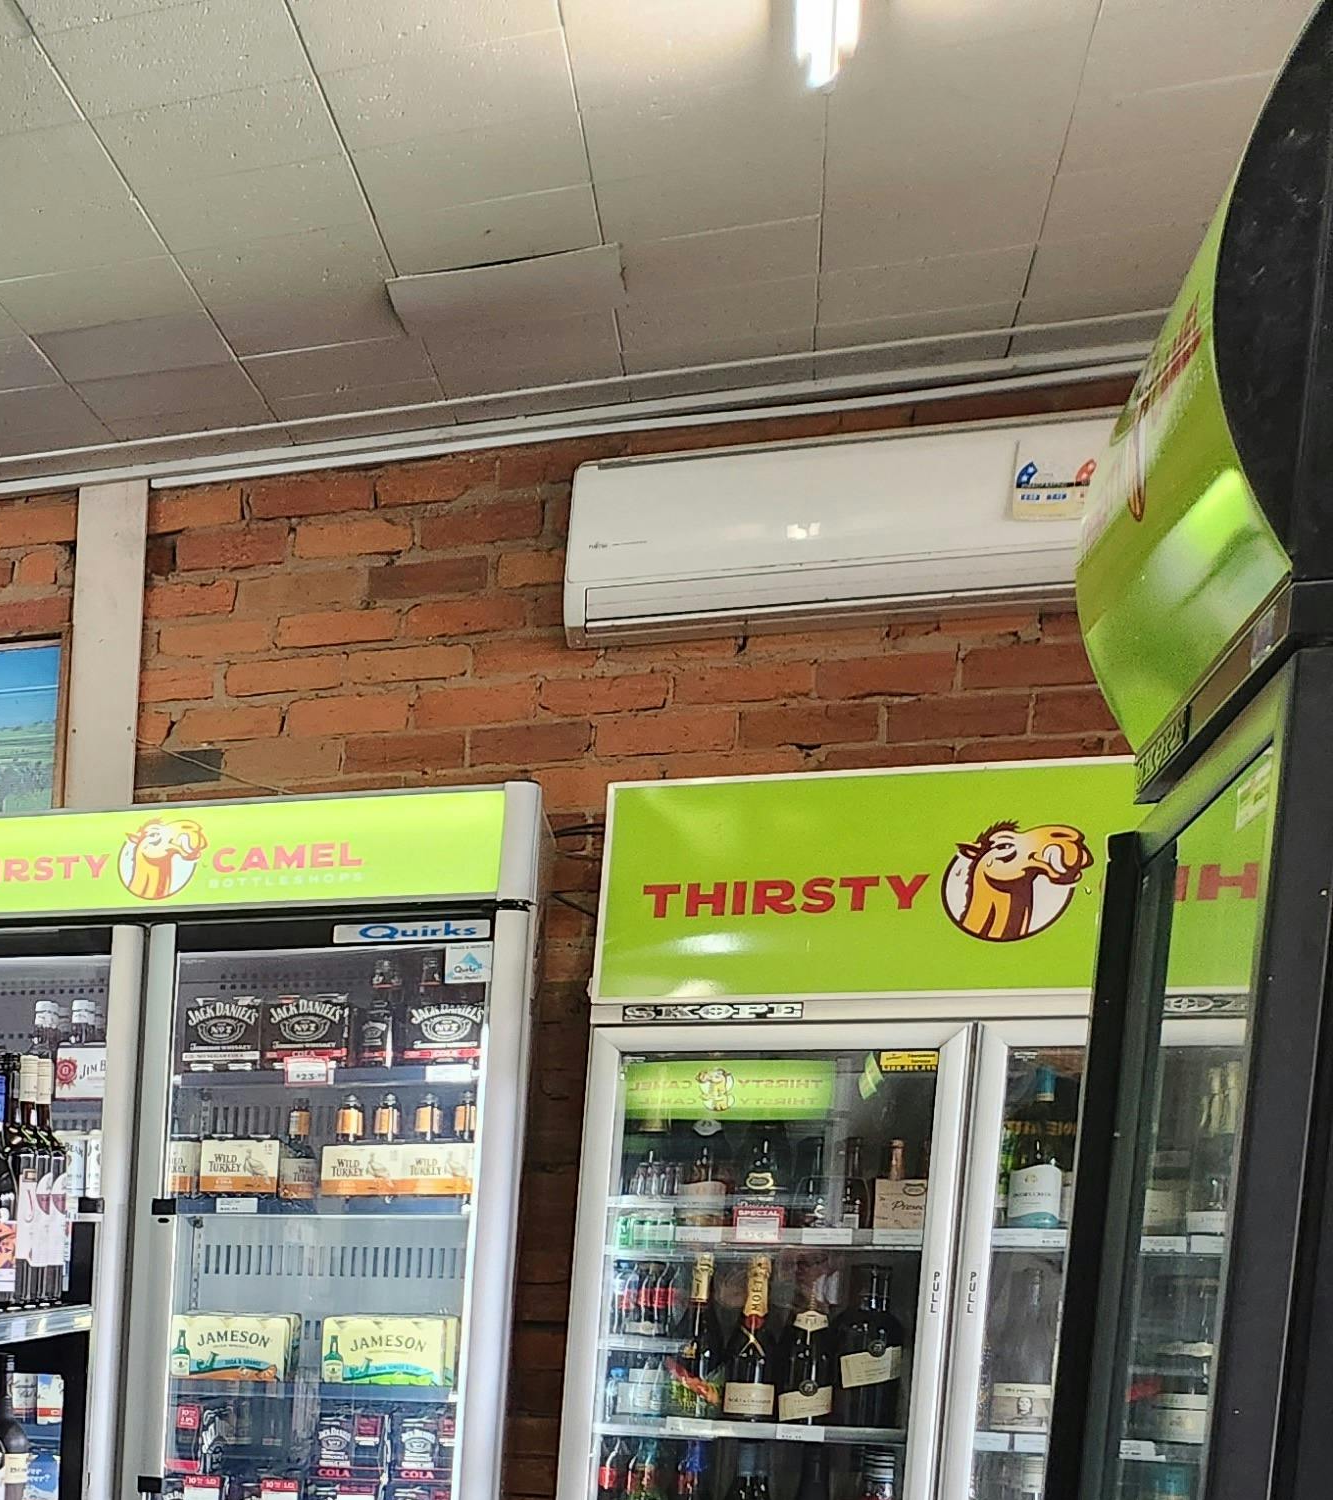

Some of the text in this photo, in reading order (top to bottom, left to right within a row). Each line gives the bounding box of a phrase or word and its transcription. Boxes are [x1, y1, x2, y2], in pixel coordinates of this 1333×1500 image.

[212, 841, 363, 875] CAMEL
[207, 872, 363, 890] BOTTLESHOPS
[643, 874, 929, 919] THIRSTY
[358, 921, 477, 942] Quirks
[187, 1003, 215, 1027] JACK
[270, 1001, 298, 1024] JACK
[624, 1003, 802, 1020] SKOPE
[209, 1161, 242, 1174] TURKEY
[213, 1152, 238, 1164] WILD
[336, 1158, 360, 1169] WILD
[331, 1166, 364, 1177] TURKEY
[737, 1209, 781, 1217] SPECIAL
[930, 1271, 941, 1314] PULL
[967, 1271, 976, 1314] PULL
[196, 1329, 271, 1348] JAMESON
[350, 1334, 427, 1353] JAMESON
[401, 1469, 434, 1479] COLA
